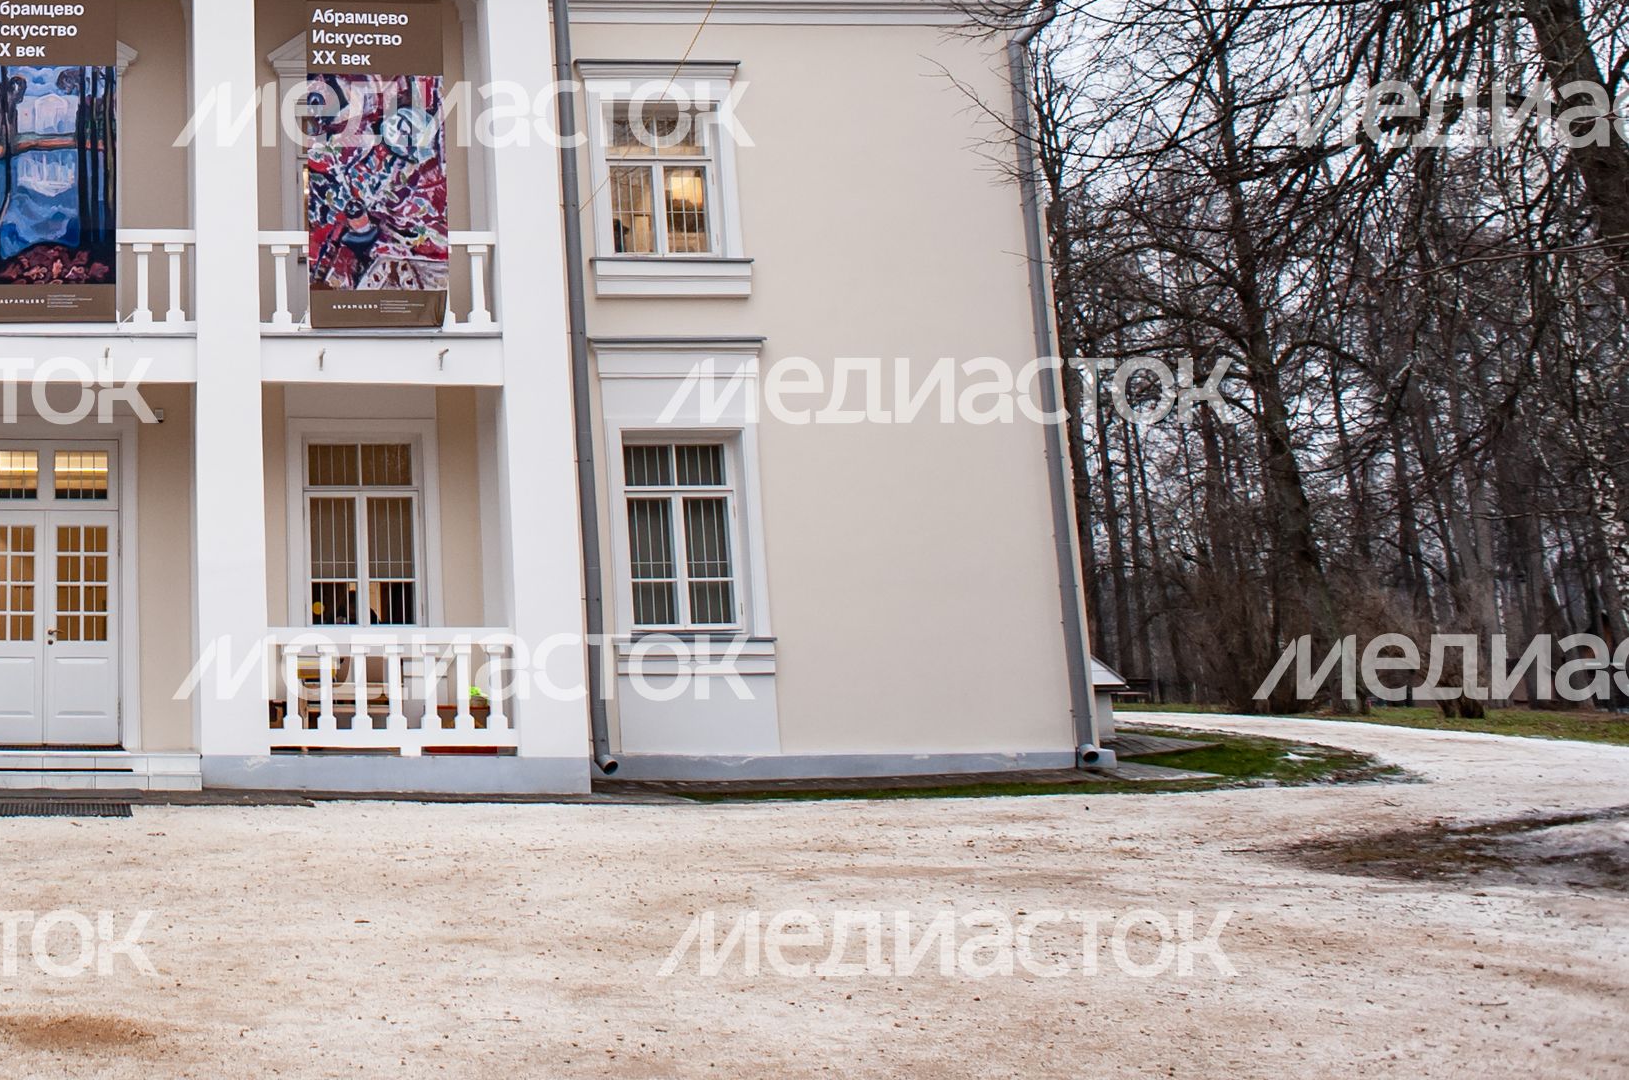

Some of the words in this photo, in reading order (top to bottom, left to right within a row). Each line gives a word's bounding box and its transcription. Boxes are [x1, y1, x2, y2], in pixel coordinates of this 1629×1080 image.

[311, 8, 409, 27] Абрамцево
[312, 29, 403, 48] Искусство
[15, 45, 46, 58] век
[341, 53, 371, 66] век
